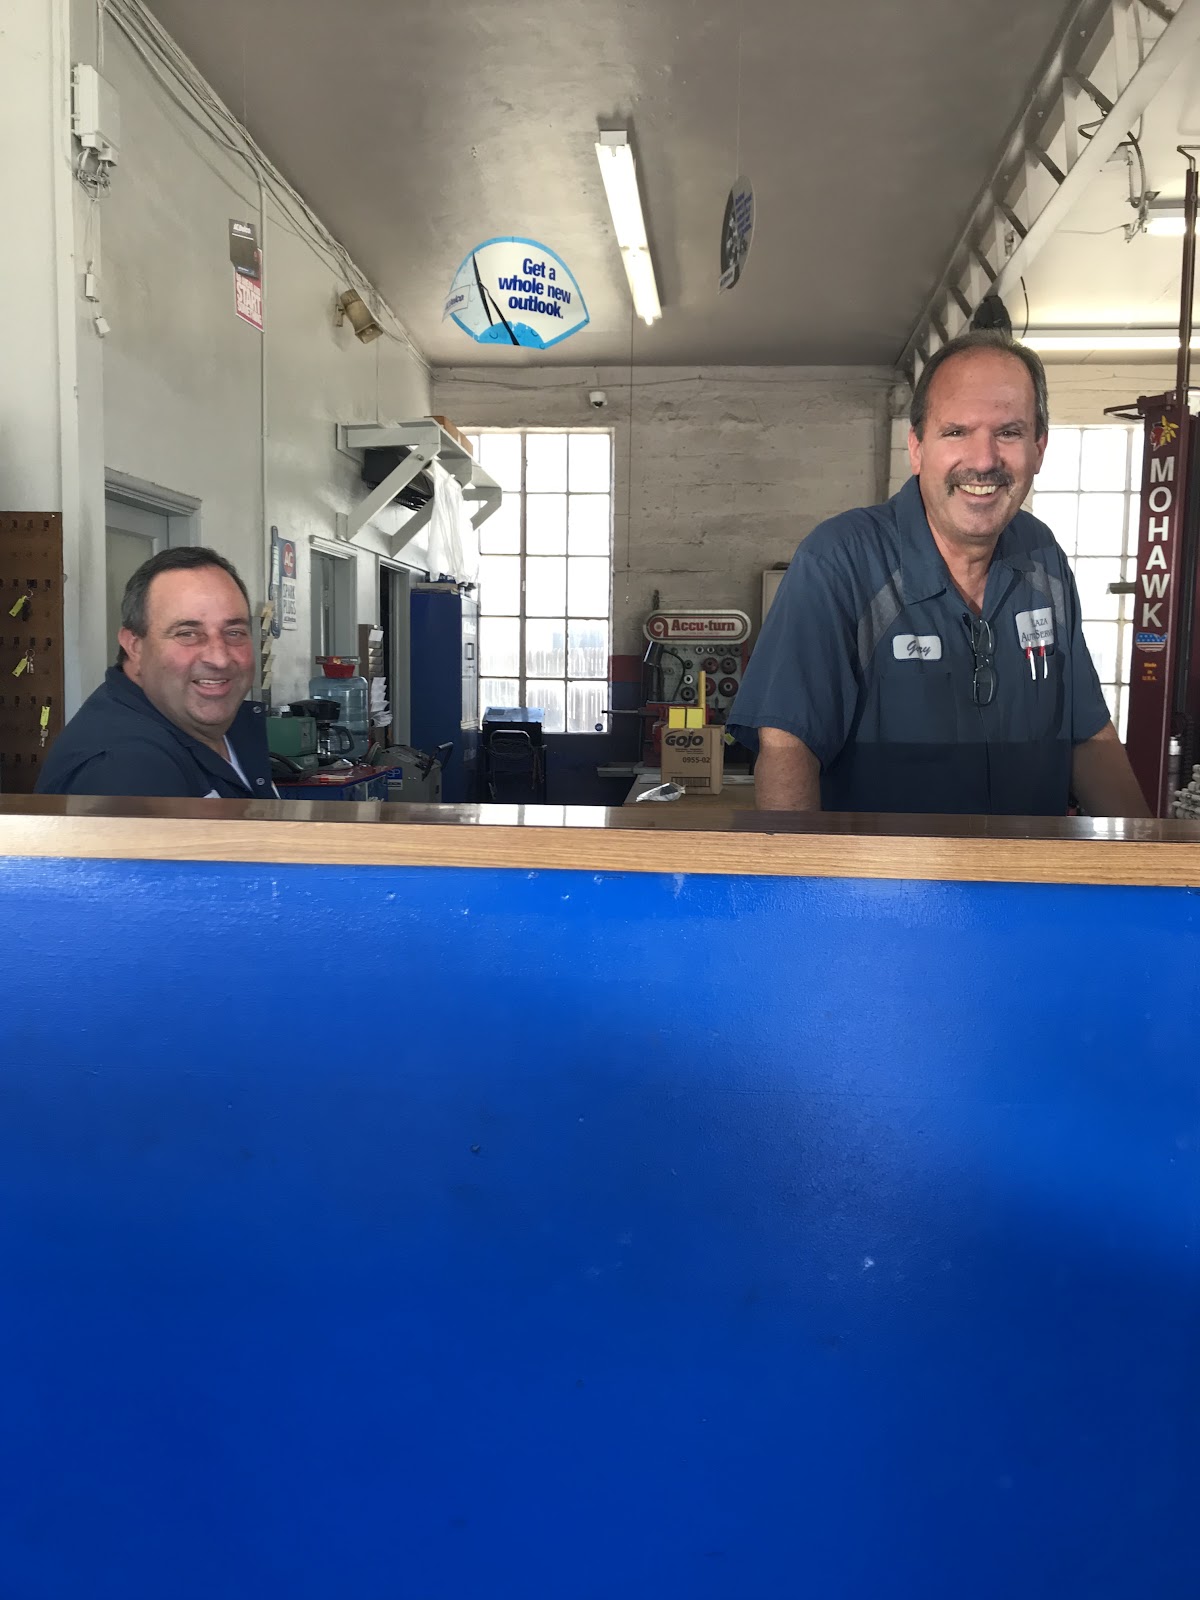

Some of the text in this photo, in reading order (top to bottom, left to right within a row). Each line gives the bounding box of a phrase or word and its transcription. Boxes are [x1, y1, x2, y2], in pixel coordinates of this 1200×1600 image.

[522, 257, 556, 281] Get a
[236, 281, 262, 316] START
[498, 275, 572, 304] whole new
[508, 295, 564, 319] outlook.
[1141, 456, 1175, 628] MOHAWK
[284, 551, 294, 568] AC
